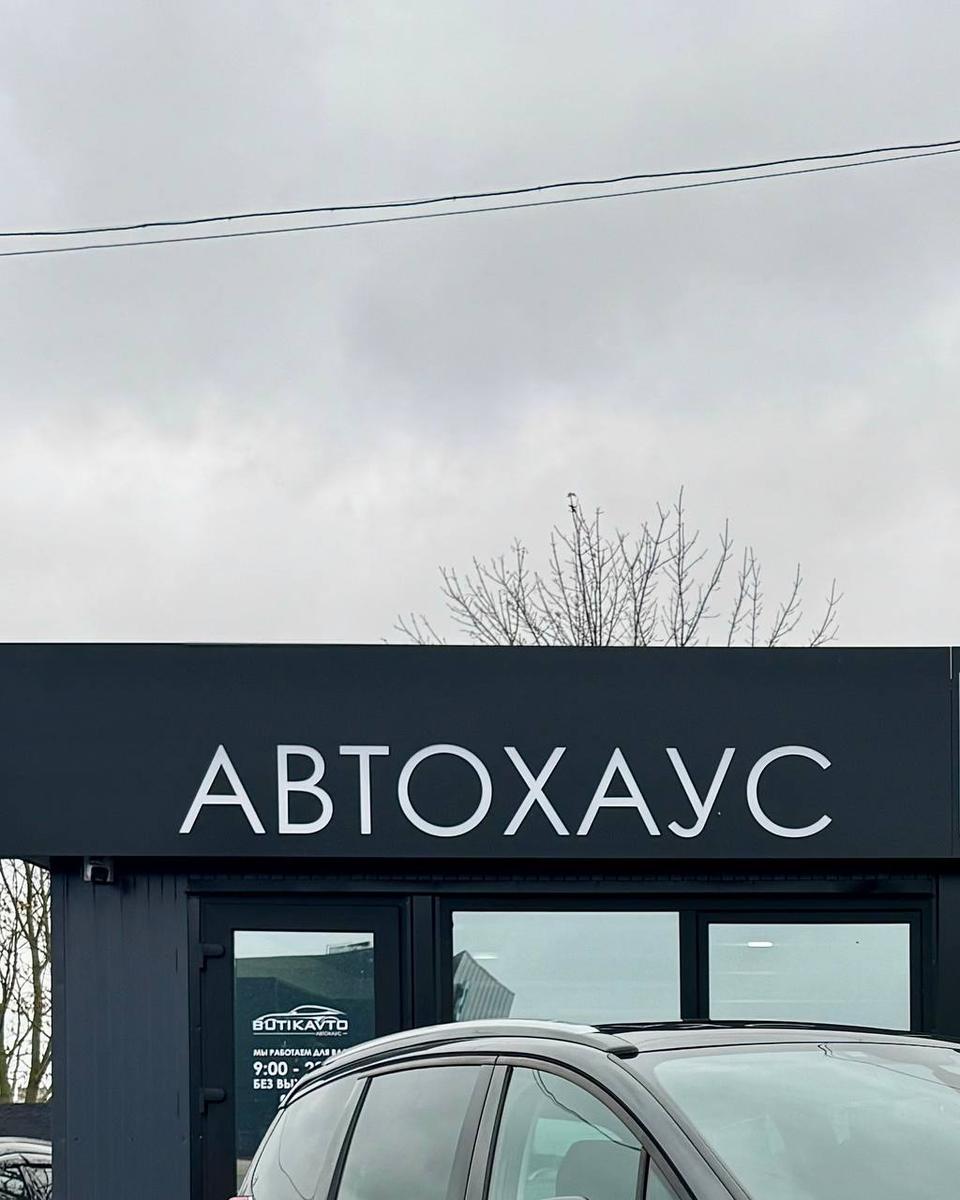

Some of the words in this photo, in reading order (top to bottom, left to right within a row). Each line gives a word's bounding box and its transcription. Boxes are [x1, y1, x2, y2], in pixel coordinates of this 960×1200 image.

[179, 743, 832, 838] АВТОХАУС
[252, 1019, 348, 1031] BUTIKAVTO
[253, 1049, 268, 1057] МЫ
[269, 1049, 312, 1057] РАБОТАЕМ
[313, 1048, 330, 1057] ДЛЯ
[253, 1061, 288, 1076] 9:00
[253, 1078, 273, 1089] БЕЗ
